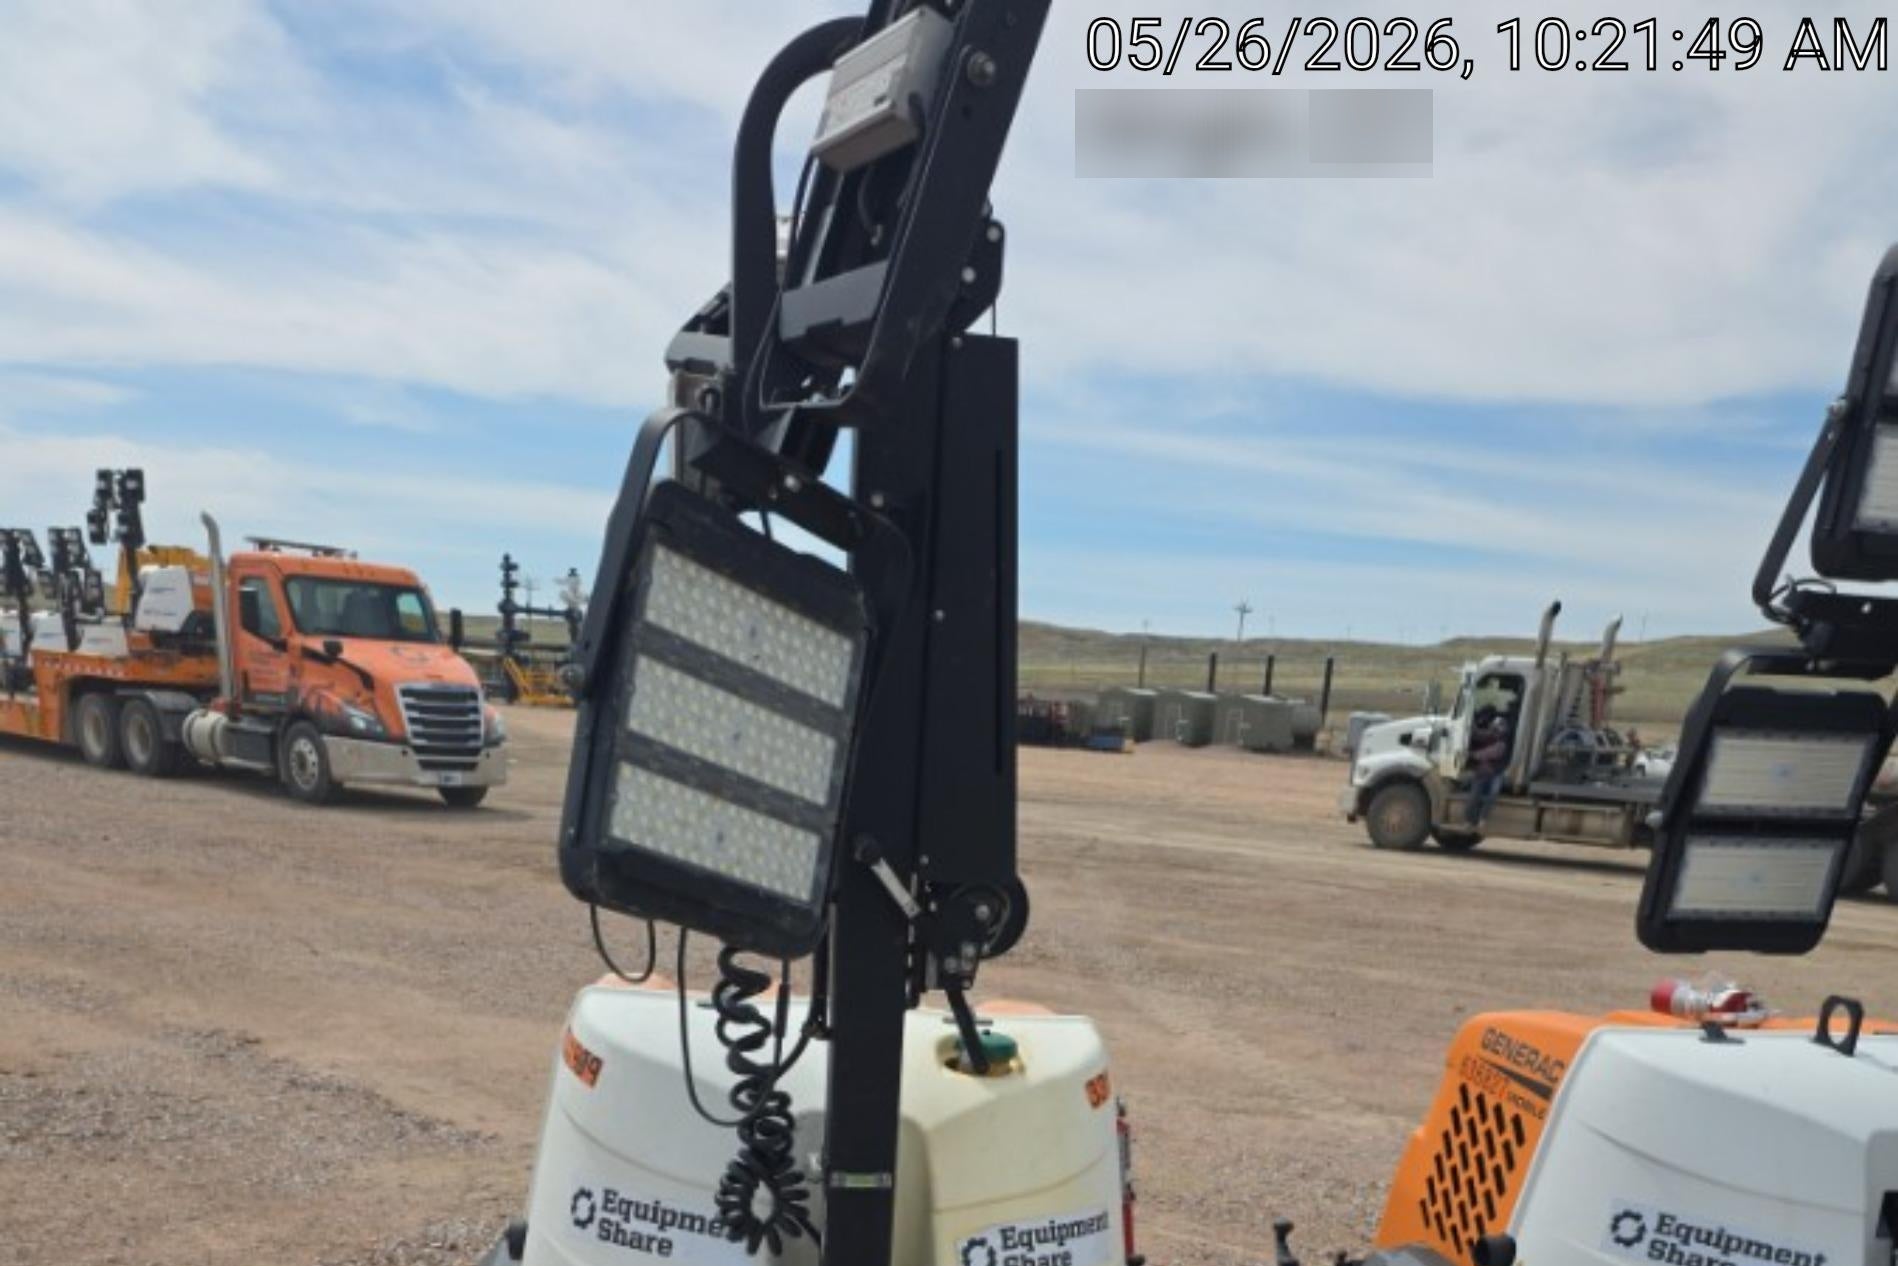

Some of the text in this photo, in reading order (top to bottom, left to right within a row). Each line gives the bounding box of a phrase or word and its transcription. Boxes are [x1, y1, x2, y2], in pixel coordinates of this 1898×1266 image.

[1482, 1026, 1565, 1083] GENERAC
[597, 1217, 674, 1258] Share
[601, 1188, 731, 1239] Equipme
